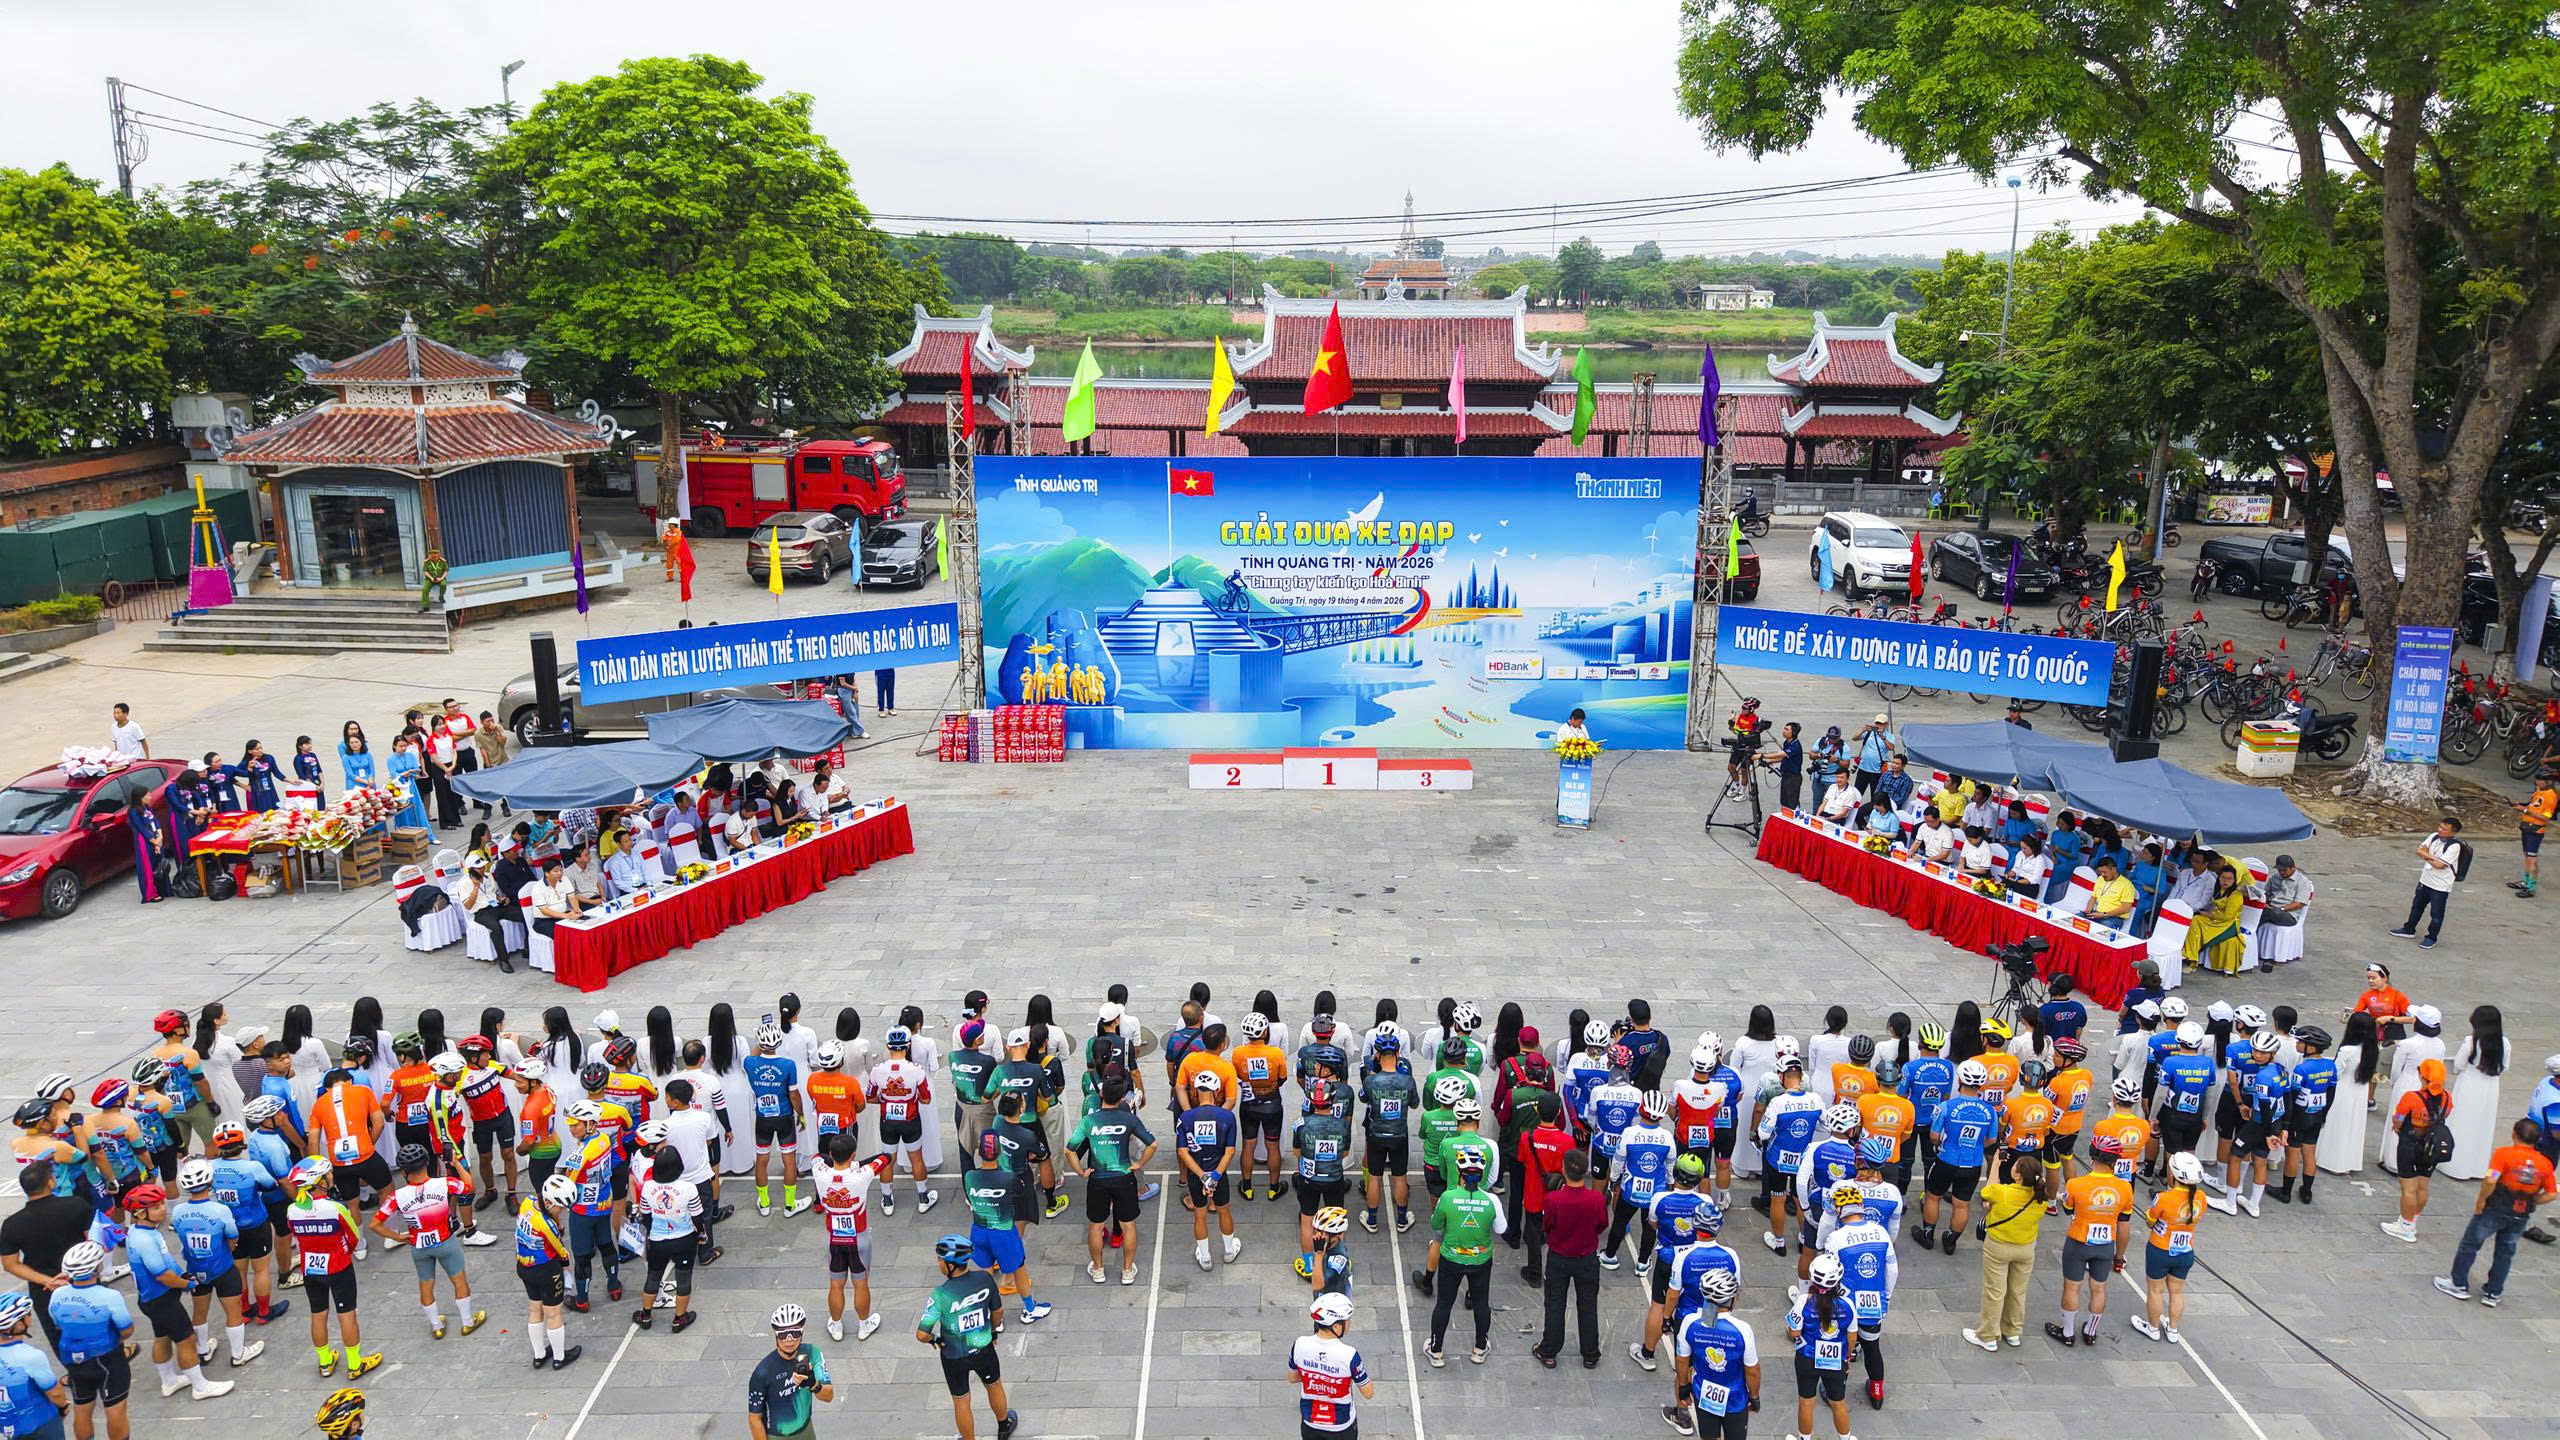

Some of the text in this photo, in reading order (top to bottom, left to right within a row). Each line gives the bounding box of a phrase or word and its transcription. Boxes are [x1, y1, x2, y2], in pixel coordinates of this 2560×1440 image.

[1014, 474, 1098, 495] TỈNH QUẢNG TRỊ
[1221, 511, 1454, 554] GIẢI ĐUA XE ĐẠP
[1241, 554, 1434, 572] TỈNH QUẢNG TRỊ NĂM 2026
[1293, 576, 1314, 591] tay
[1316, 575, 1344, 588] kiến
[1346, 576, 1368, 590] tạo
[1369, 576, 1393, 589] Hoà
[1270, 596, 1297, 606] Quảng
[1308, 598, 1327, 606] ngày
[1328, 597, 1336, 605] 19
[1337, 596, 1359, 606] tháng
[1360, 597, 1365, 605] 4
[1367, 597, 1383, 605] năm
[1384, 597, 1404, 605] 2026
[590, 617, 950, 686] TOÀN DÂN RÈN LUYỆN THÂN THỂ THEO GƯƠNG BÁC HỒ VĨ ĐẠI
[1735, 620, 2089, 687] KHỎE ĐỂ XÂY DỰNG VÀ BẢO VỆ TỔ QUỐC
[1489, 662, 1529, 671] HDBank
[1609, 668, 1637, 676] Vinamilk
[2399, 666, 2442, 681] CHÀO MỪNG
[2407, 680, 2430, 699] LỄ HỘI
[2420, 700, 2438, 714] BÌNH
[2396, 716, 2432, 730] NĂM 2026
[1226, 767, 1241, 786] 2
[1322, 762, 1337, 786] 1
[1420, 771, 1432, 787] 3
[952, 1062, 982, 1073] MBO
[1251, 1059, 1265, 1070] 142
[1001, 1078, 1033, 1087] MBO
[1925, 1088, 1940, 1098] 252
[1988, 1091, 2002, 1100] 218
[760, 1095, 776, 1106] 304
[2074, 1094, 2087, 1105] 213
[2184, 1095, 2197, 1105] 40
[2312, 1095, 2322, 1106] 41
[890, 1105, 904, 1116] 163
[1384, 1102, 1399, 1112] 230
[821, 1115, 836, 1127] 206
[1091, 1125, 1126, 1135] MBO
[1198, 1123, 1214, 1136] 272
[1692, 1128, 1707, 1139] 258
[1962, 1127, 1975, 1139] 20
[342, 1139, 350, 1152] 6
[1000, 1135, 1020, 1150] BO
[1319, 1142, 1334, 1153] 234
[1782, 1153, 1798, 1165] 307
[2117, 1161, 2130, 1173] 216
[1636, 1180, 1651, 1190] 310
[583, 1186, 597, 1203] 238
[970, 1187, 1006, 1198] MBO
[836, 1217, 852, 1229] 160
[2092, 1227, 2108, 1239] 113
[191, 1236, 208, 1249] 116
[421, 1233, 437, 1247] 108
[2174, 1234, 2190, 1246] 401
[309, 1255, 326, 1269] 242
[949, 1288, 990, 1314] MBO
[1859, 1293, 1878, 1307] 309
[963, 1312, 980, 1330] 267
[1820, 1345, 1839, 1359] 420
[779, 1386, 796, 1397] VIET
[1705, 1385, 1725, 1403] 260
